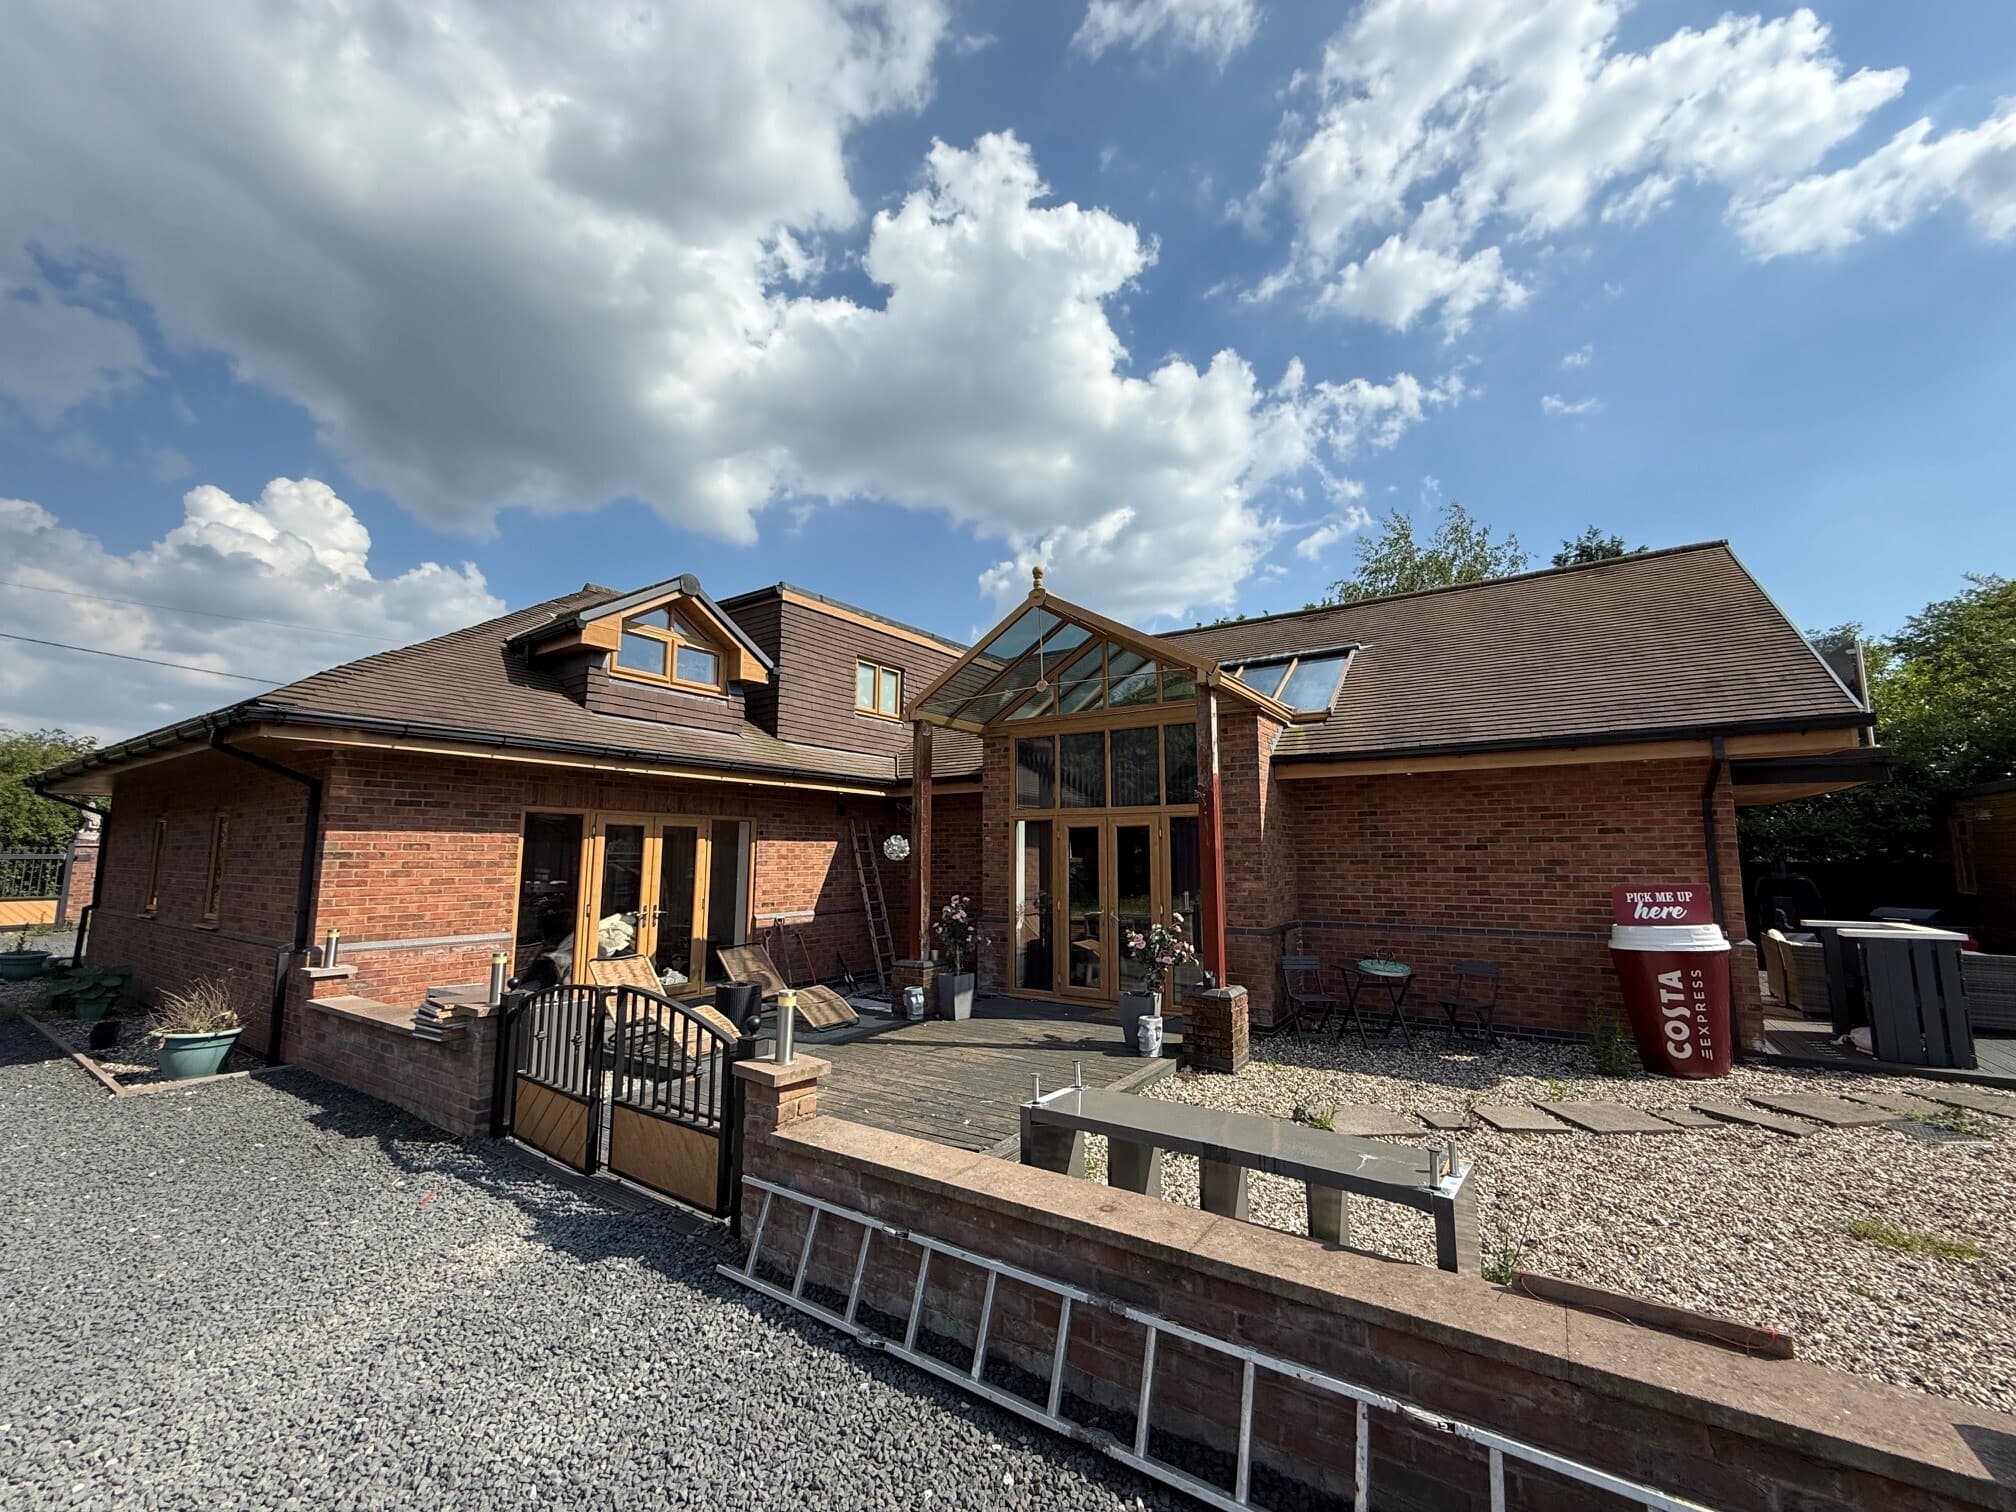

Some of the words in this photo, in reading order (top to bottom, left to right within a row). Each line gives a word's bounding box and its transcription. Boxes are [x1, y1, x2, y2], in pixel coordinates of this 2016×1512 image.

[1625, 892, 1654, 903] PICK
[1655, 892, 1674, 902] ME
[1677, 891, 1693, 902] UP
[1633, 901, 1688, 920] here
[1657, 969, 1693, 1059] COSTA
[1690, 969, 1712, 1047] EXPRESS
